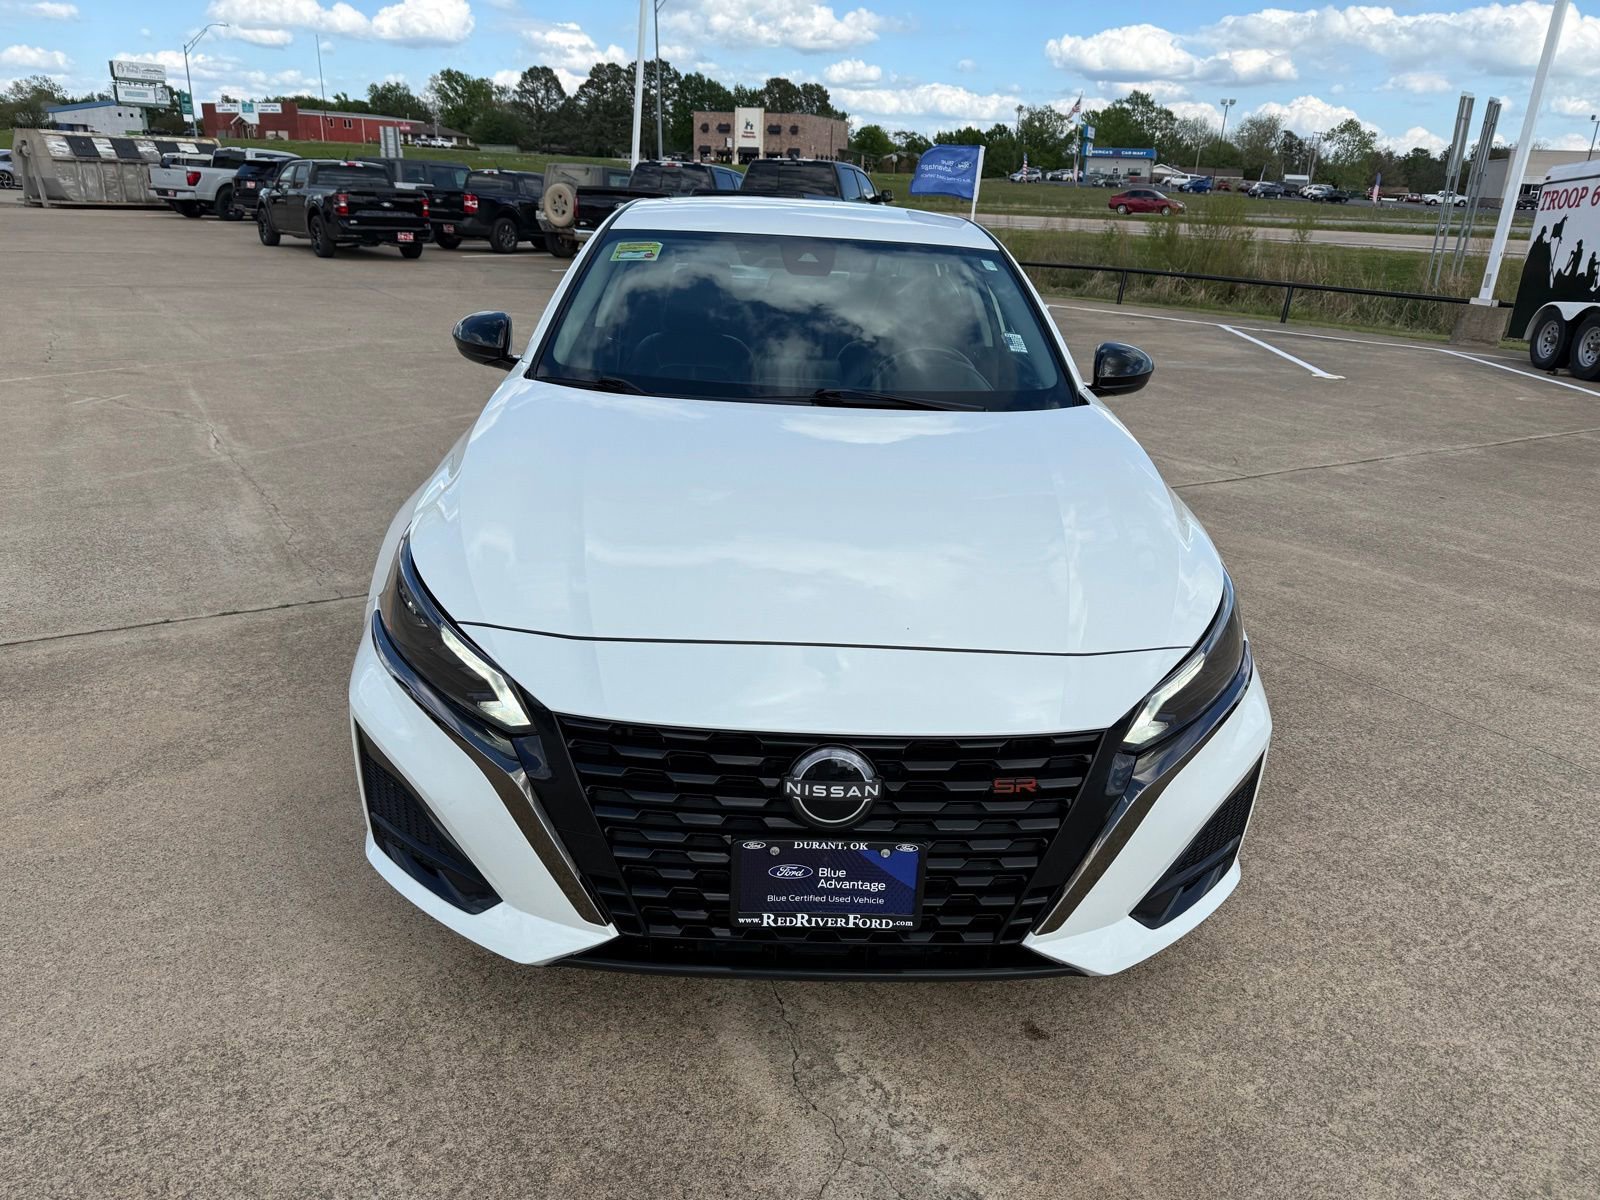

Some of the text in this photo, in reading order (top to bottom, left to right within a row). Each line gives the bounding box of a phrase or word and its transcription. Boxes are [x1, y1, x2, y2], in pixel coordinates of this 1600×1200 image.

[1540, 186, 1589, 211] TROOP
[786, 781, 879, 797] NISSAN
[993, 777, 1037, 793] SR
[793, 841, 847, 850] DURANT,
[850, 842, 869, 851] OK
[776, 866, 847, 878] Ford Blue
[817, 879, 886, 892] Advantage
[767, 894, 885, 905] Blue Certified Used Vehicle
